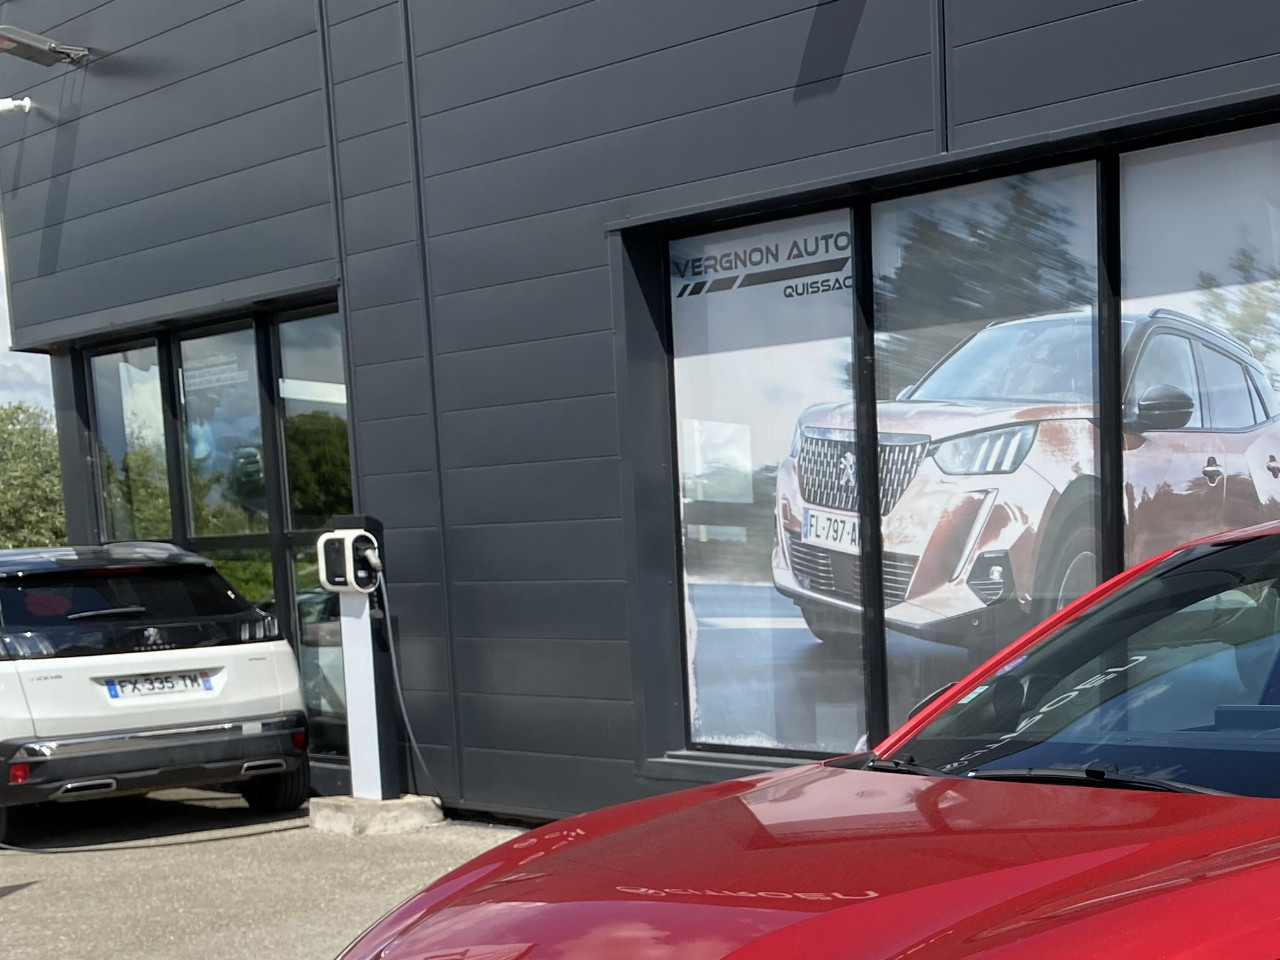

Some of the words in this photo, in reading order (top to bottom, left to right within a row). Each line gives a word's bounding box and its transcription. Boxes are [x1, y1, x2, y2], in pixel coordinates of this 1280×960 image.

[674, 244, 779, 279] VERGNON
[786, 231, 851, 260] AUTO
[783, 276, 852, 298] QUISSAC
[808, 514, 860, 546] FL-797-A
